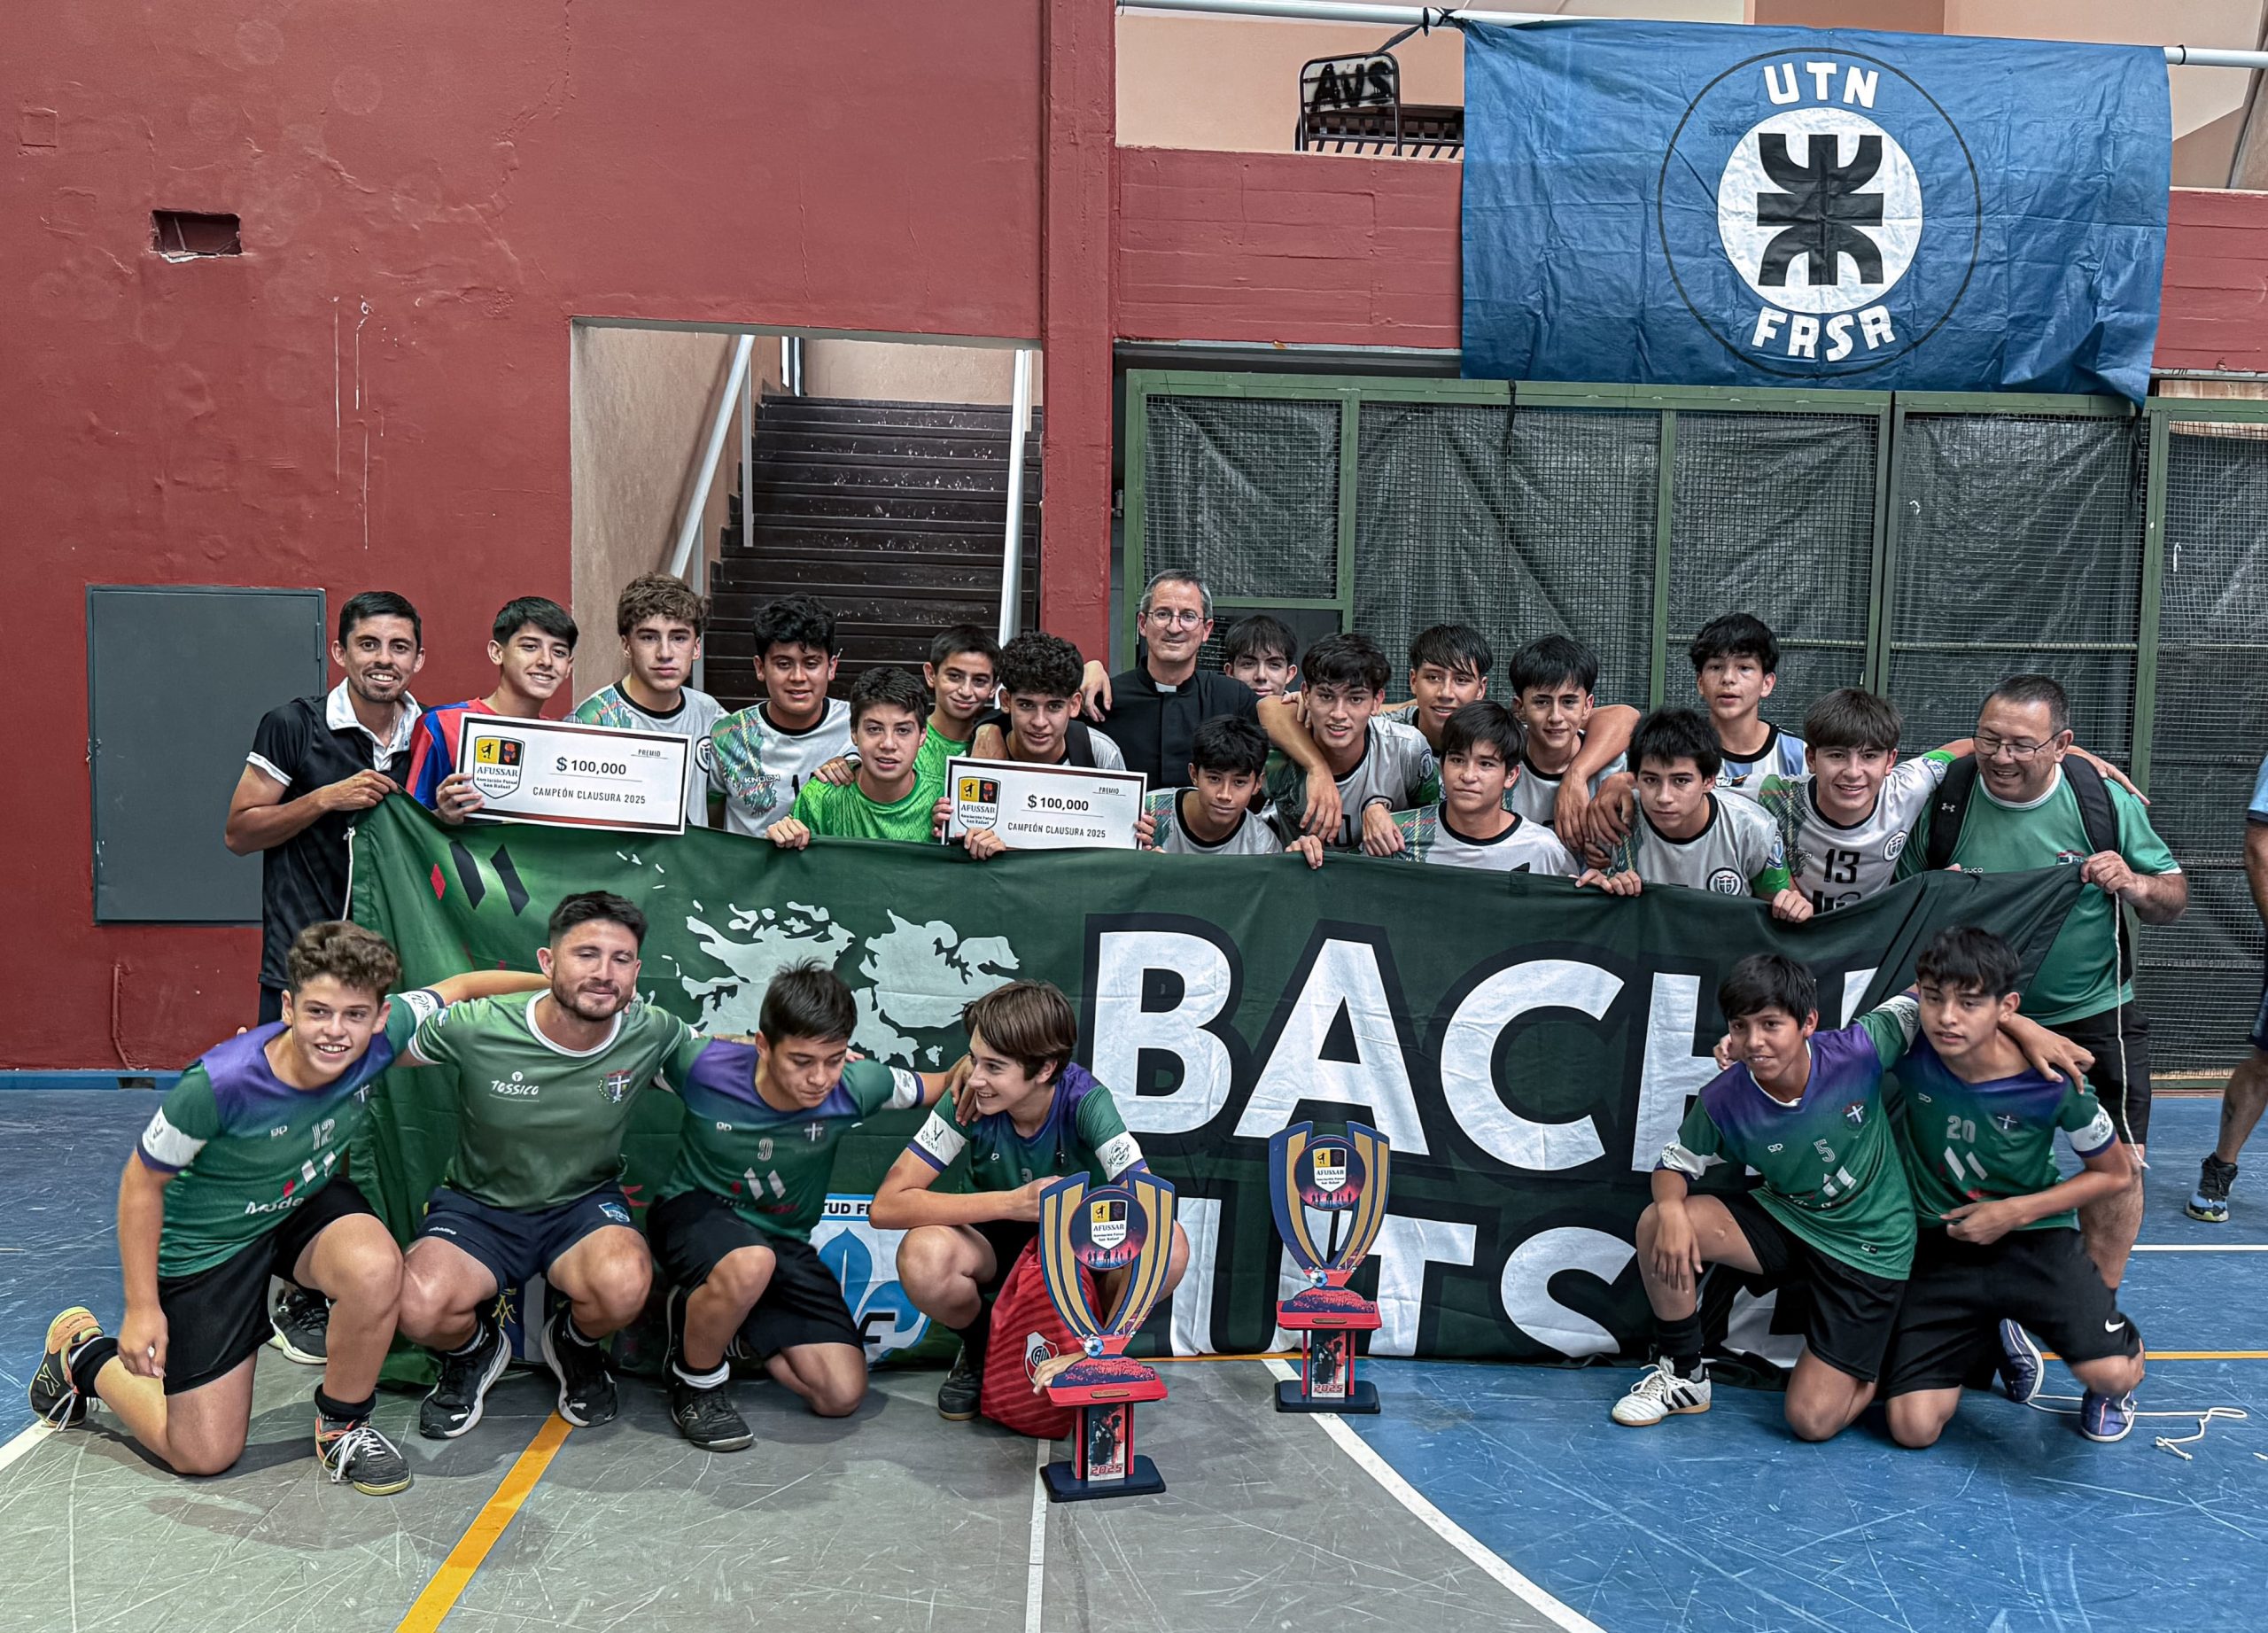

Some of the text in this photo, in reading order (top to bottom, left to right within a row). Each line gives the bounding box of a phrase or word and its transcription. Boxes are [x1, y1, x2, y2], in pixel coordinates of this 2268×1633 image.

[1763, 61, 1879, 108] UTN
[1751, 305, 1896, 362] FRSR
[638, 749, 661, 758] PREMIO
[477, 766, 518, 777] AFUSSAR
[555, 756, 626, 775] $ 100,000
[532, 786, 646, 805] CAMPEÓN CLAUSURA 2025
[1028, 794, 1089, 812] $ 100,000
[961, 804, 996, 813] AFUSSAR
[1007, 822, 1107, 838] CAMPEÓN CLAUSURA 2025
[1824, 848, 1861, 883] 13
[1091, 930, 1878, 1172] BACH
[490, 1080, 540, 1096] TOSSICO
[312, 1118, 336, 1150] 12
[1946, 1116, 1977, 1143] 20
[757, 1138, 773, 1162] 9
[1814, 1139, 1836, 1163] 5
[1313, 1384, 1343, 1393] 2025
[1091, 1464, 1122, 1474] 2025
